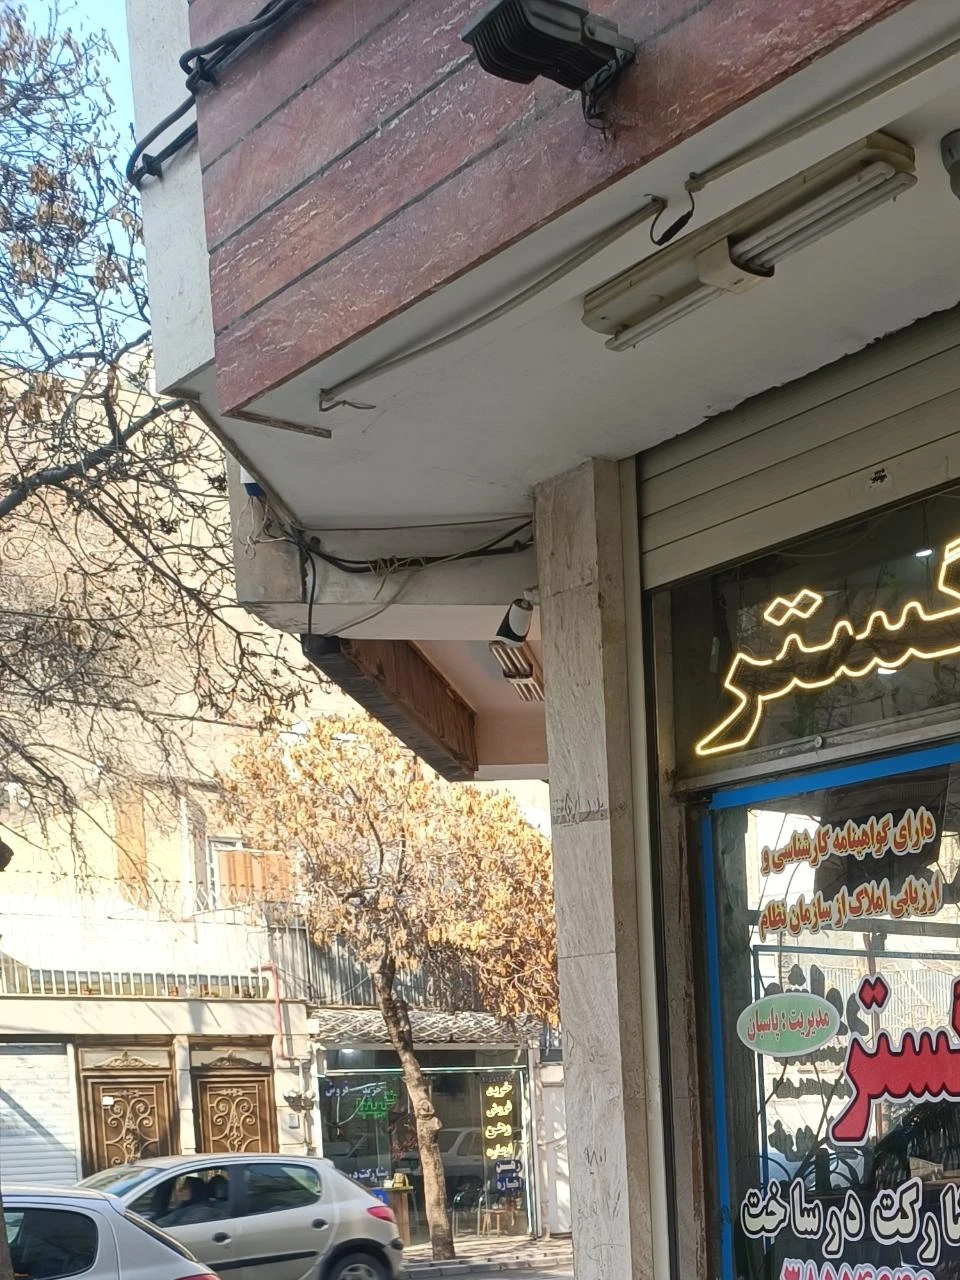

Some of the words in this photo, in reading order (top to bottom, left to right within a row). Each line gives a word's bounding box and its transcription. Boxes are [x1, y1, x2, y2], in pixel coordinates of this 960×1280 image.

[772, 825, 832, 868] کارشناسی
[893, 807, 936, 854] دارای
[761, 846, 771, 877] و
[788, 891, 832, 937] سازمان
[831, 886, 848, 930] از
[848, 878, 890, 917] املاک
[890, 871, 943, 919] ارزیابی
[759, 899, 787, 943] نظام
[747, 1007, 779, 1041] پاسبان
[741, 1177, 821, 1240] ساخت
[822, 1189, 865, 1259] در
